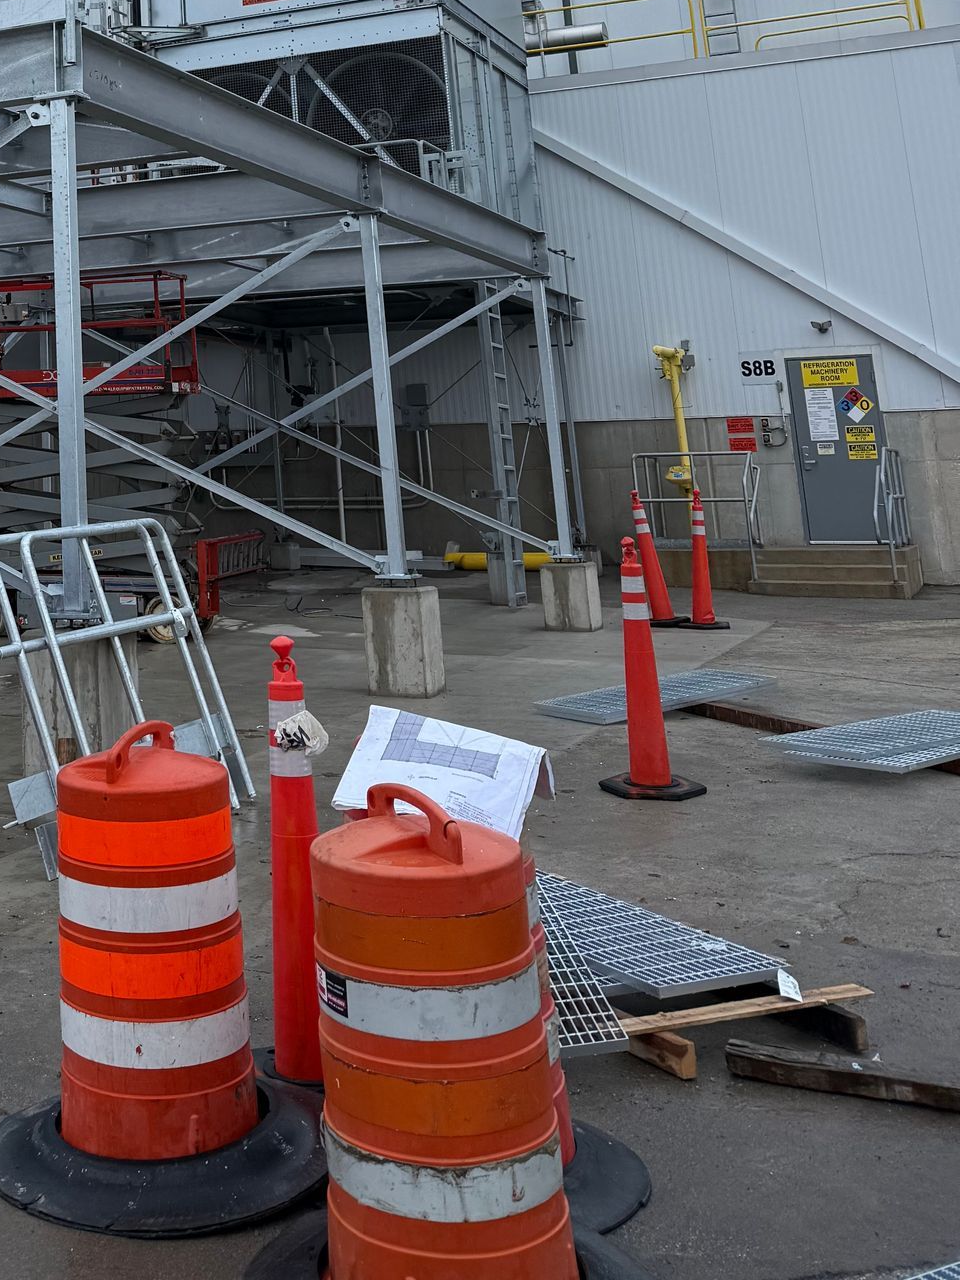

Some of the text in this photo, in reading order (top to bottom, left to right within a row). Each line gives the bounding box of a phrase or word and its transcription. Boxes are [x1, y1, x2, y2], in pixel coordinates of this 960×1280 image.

[741, 360, 776, 377] S8B
[803, 361, 854, 369] REFRIGERATION
[849, 391, 859, 402] 3
[841, 399, 870, 412] 3 0
[850, 444, 875, 452] CAUTION
